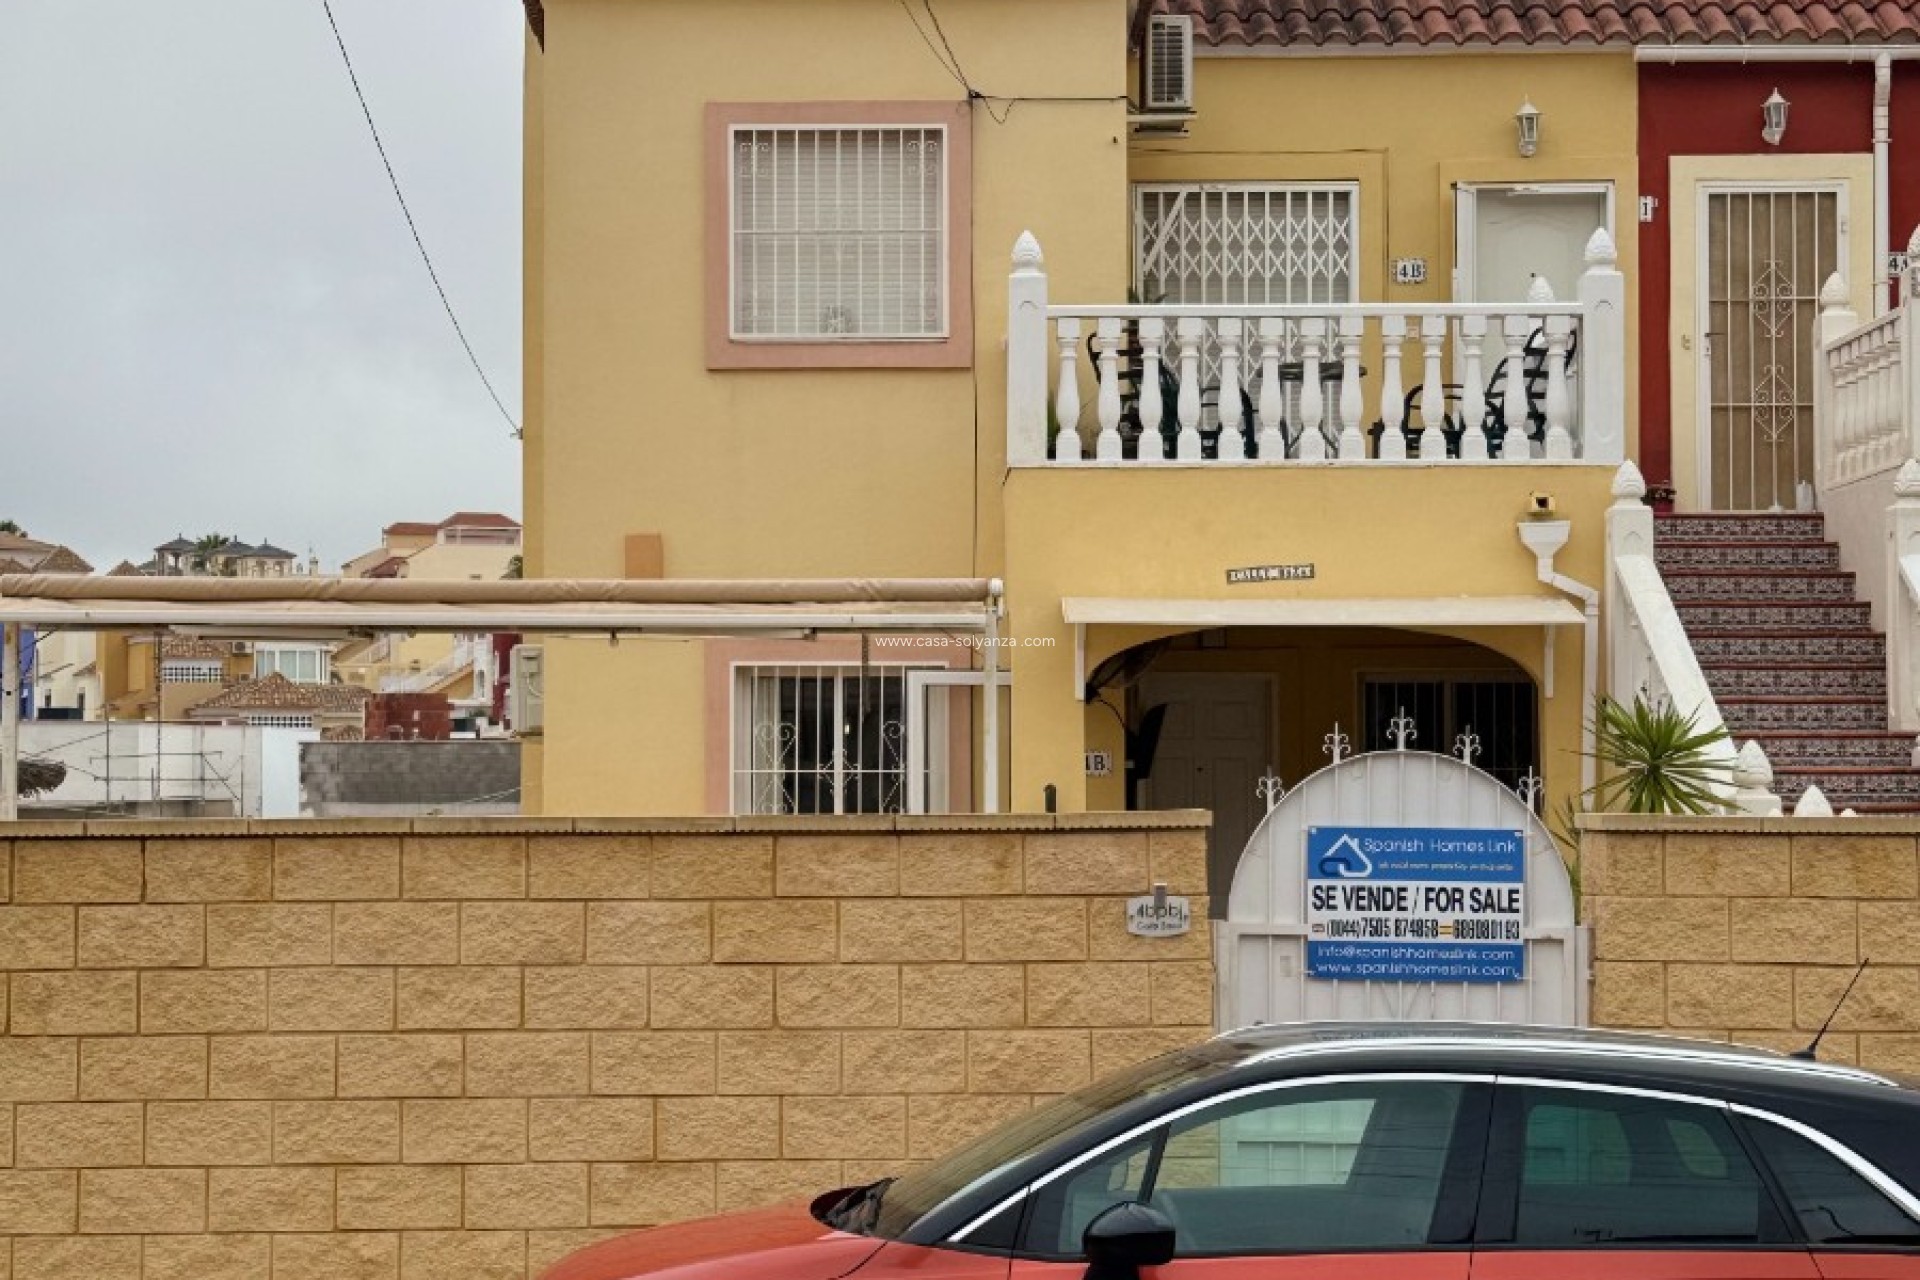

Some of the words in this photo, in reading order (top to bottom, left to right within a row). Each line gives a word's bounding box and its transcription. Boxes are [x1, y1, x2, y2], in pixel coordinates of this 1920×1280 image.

[1399, 263, 1422, 278] 4B
[1364, 837, 1424, 854] Spanish
[1431, 838, 1484, 852] Homes
[1488, 839, 1516, 853] Link
[1311, 884, 1338, 912] SE
[1341, 884, 1409, 912] VENDE
[1424, 886, 1464, 913] FOR
[1469, 886, 1520, 914] SALE
